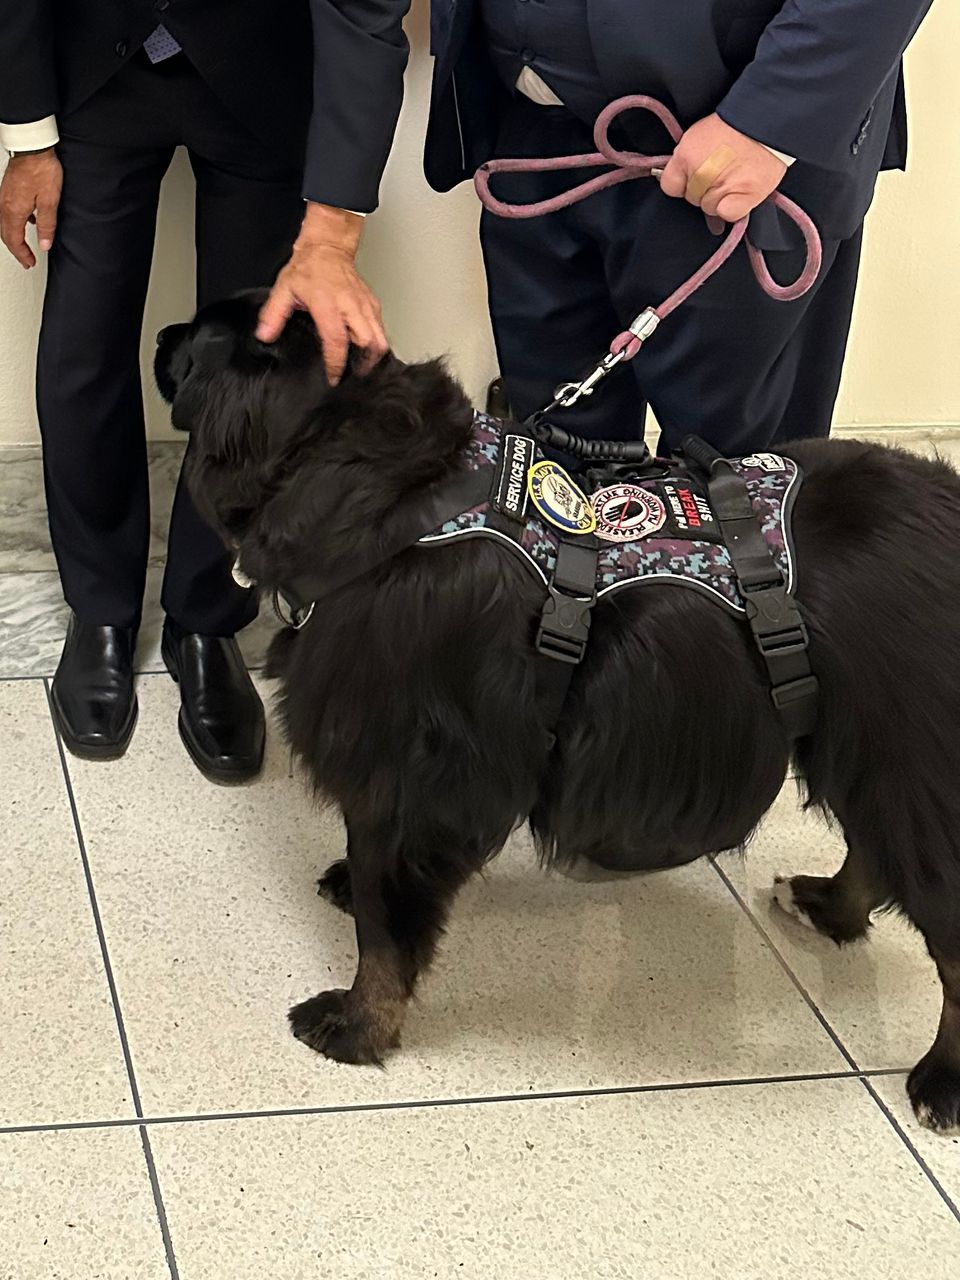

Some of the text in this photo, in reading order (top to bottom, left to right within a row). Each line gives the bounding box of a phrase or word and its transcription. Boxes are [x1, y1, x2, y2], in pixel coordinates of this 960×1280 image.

[505, 439, 527, 512] SERVICE DOG
[623, 488, 660, 513] WORKING
[664, 485, 676, 495] TO
[668, 495, 684, 516] HERE
[677, 489, 701, 527] BREAK
[692, 493, 713, 522] SHIT
[606, 523, 646, 536] PLEASE
